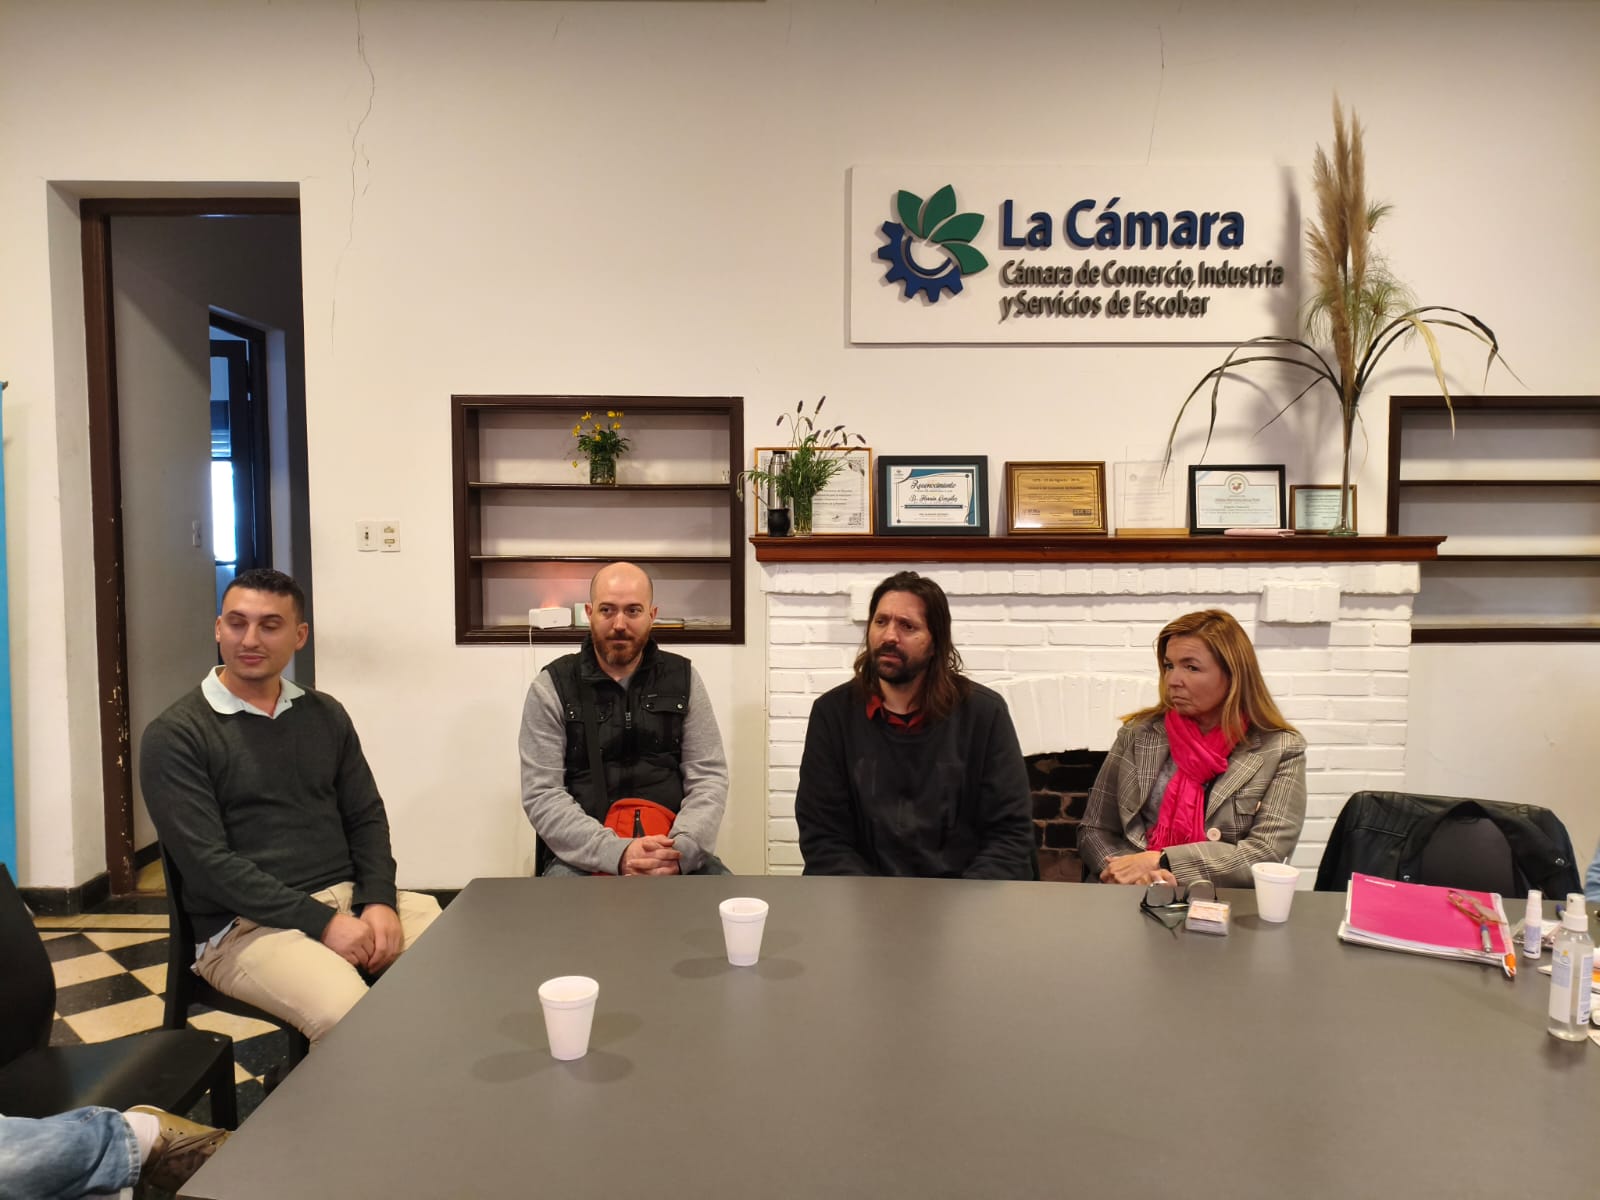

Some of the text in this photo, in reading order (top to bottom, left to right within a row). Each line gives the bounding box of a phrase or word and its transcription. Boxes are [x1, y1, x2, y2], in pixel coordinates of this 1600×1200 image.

[1001, 197, 1244, 249] La Cámara
[1001, 258, 1284, 291] Cámara de Comercio, Industria
[999, 289, 1210, 324] y Servicios de Escobar
